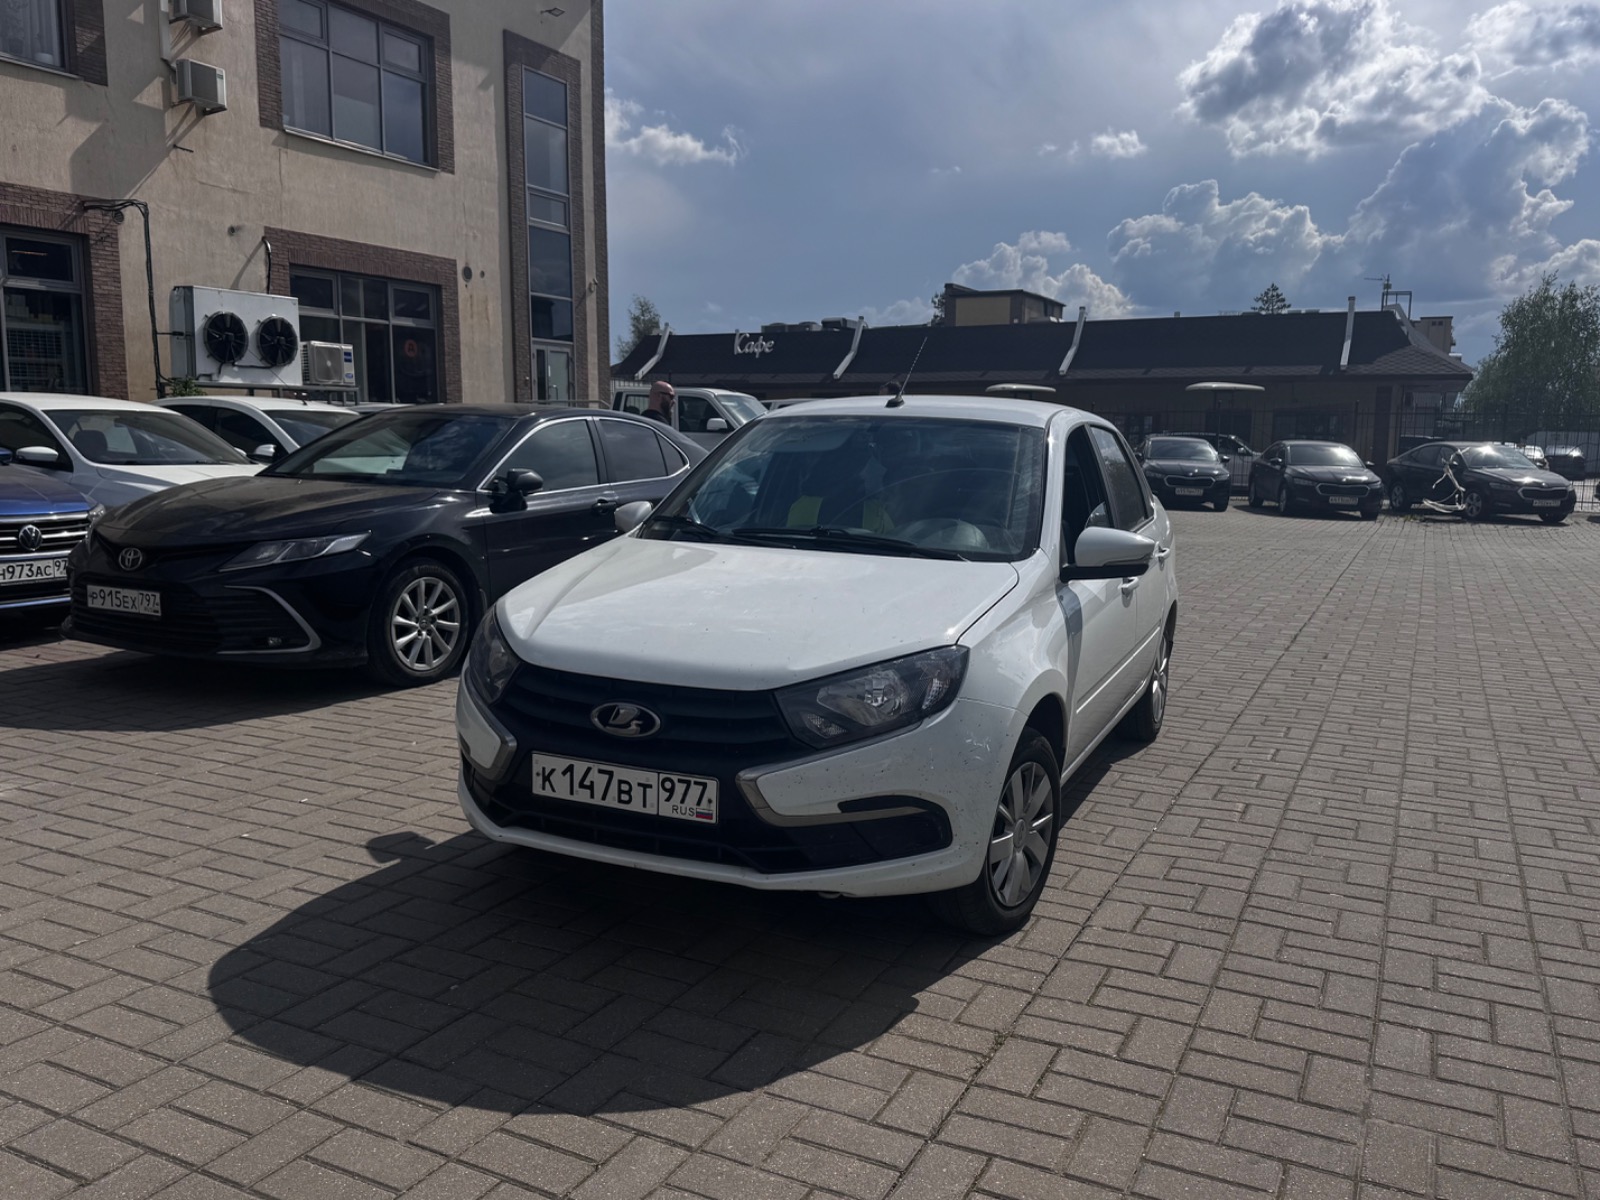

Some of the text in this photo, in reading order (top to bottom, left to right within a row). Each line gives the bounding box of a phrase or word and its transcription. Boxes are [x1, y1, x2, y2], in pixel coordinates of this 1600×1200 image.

[734, 332, 775, 358] Кафе
[0, 563, 52, 580] Н973АС
[91, 588, 156, 610] Р915ЕХ 797
[541, 763, 708, 809] К147ВТ 977
[672, 804, 695, 817] RUS
